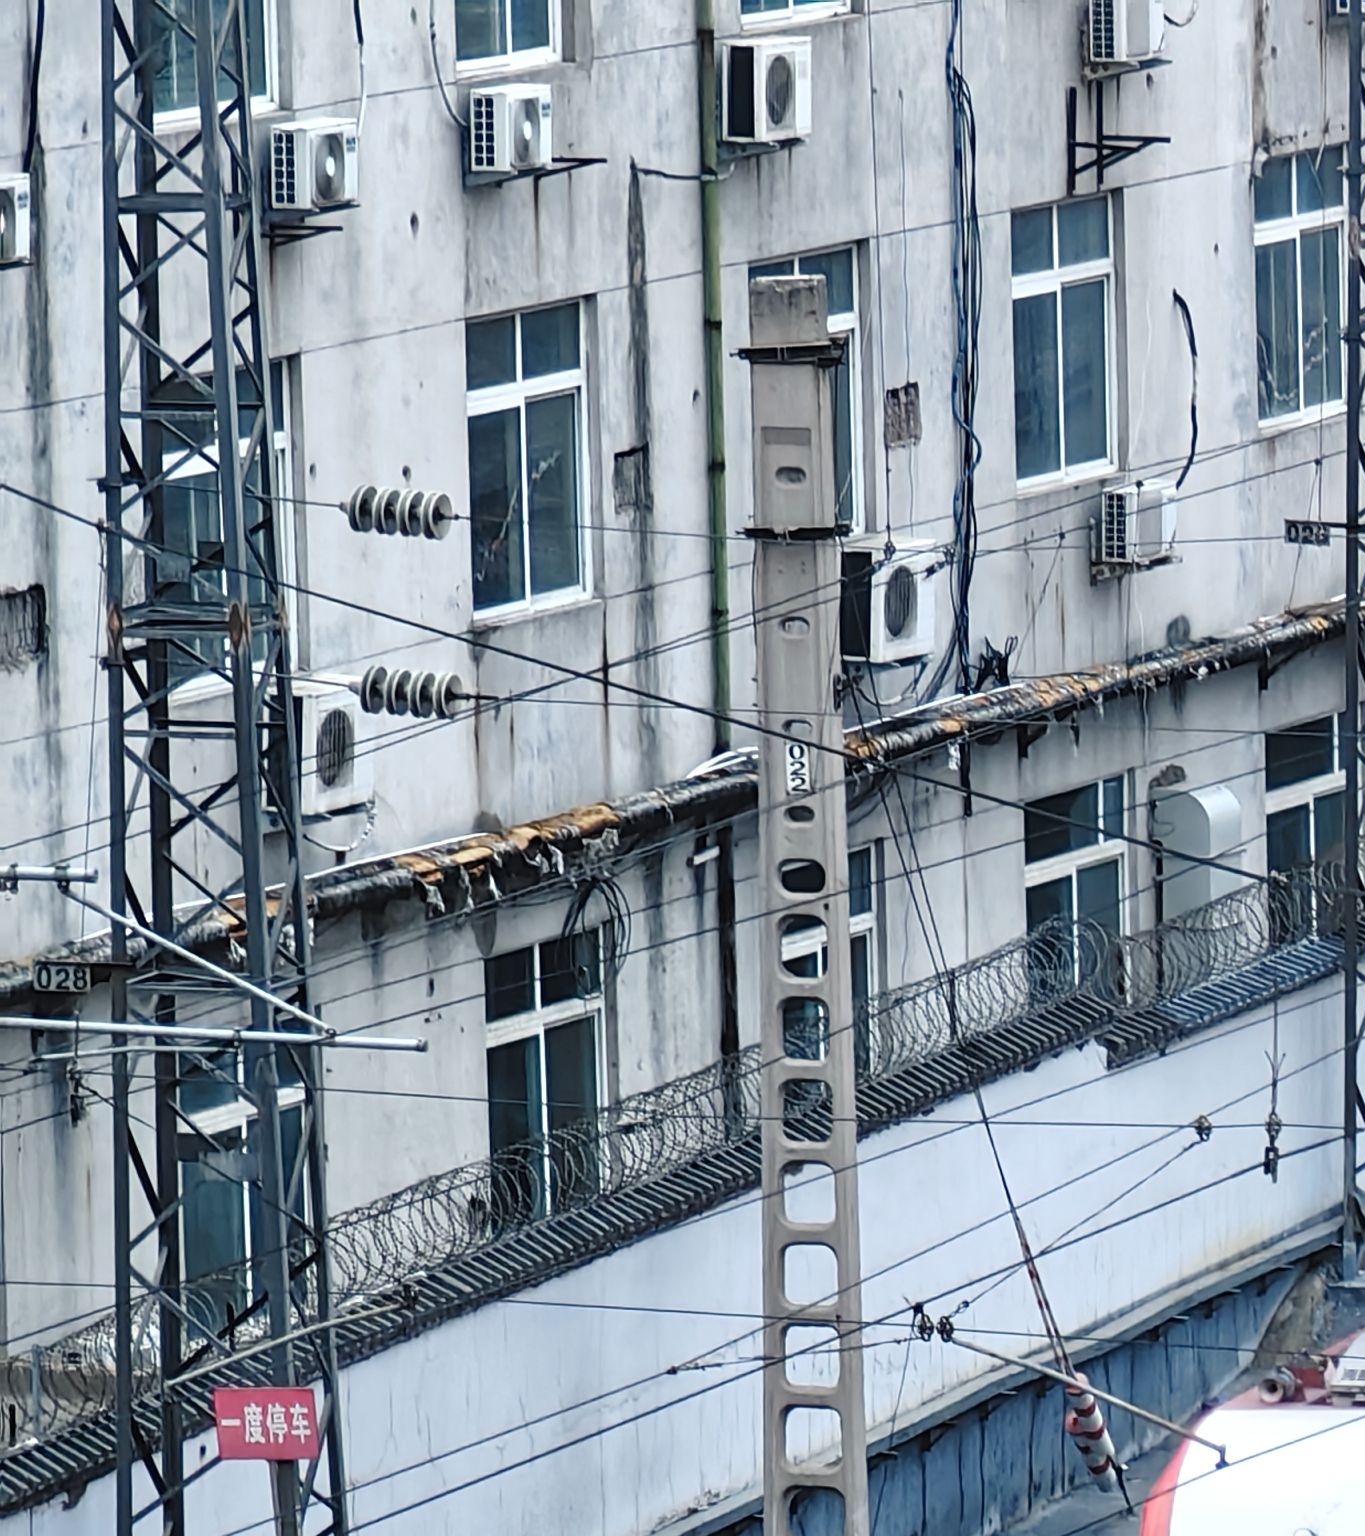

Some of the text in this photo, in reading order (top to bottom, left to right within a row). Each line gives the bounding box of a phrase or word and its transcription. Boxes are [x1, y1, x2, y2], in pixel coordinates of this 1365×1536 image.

[788, 743, 810, 794] 022
[36, 964, 88, 991] 028
[220, 1402, 312, 1445] 一度停车
